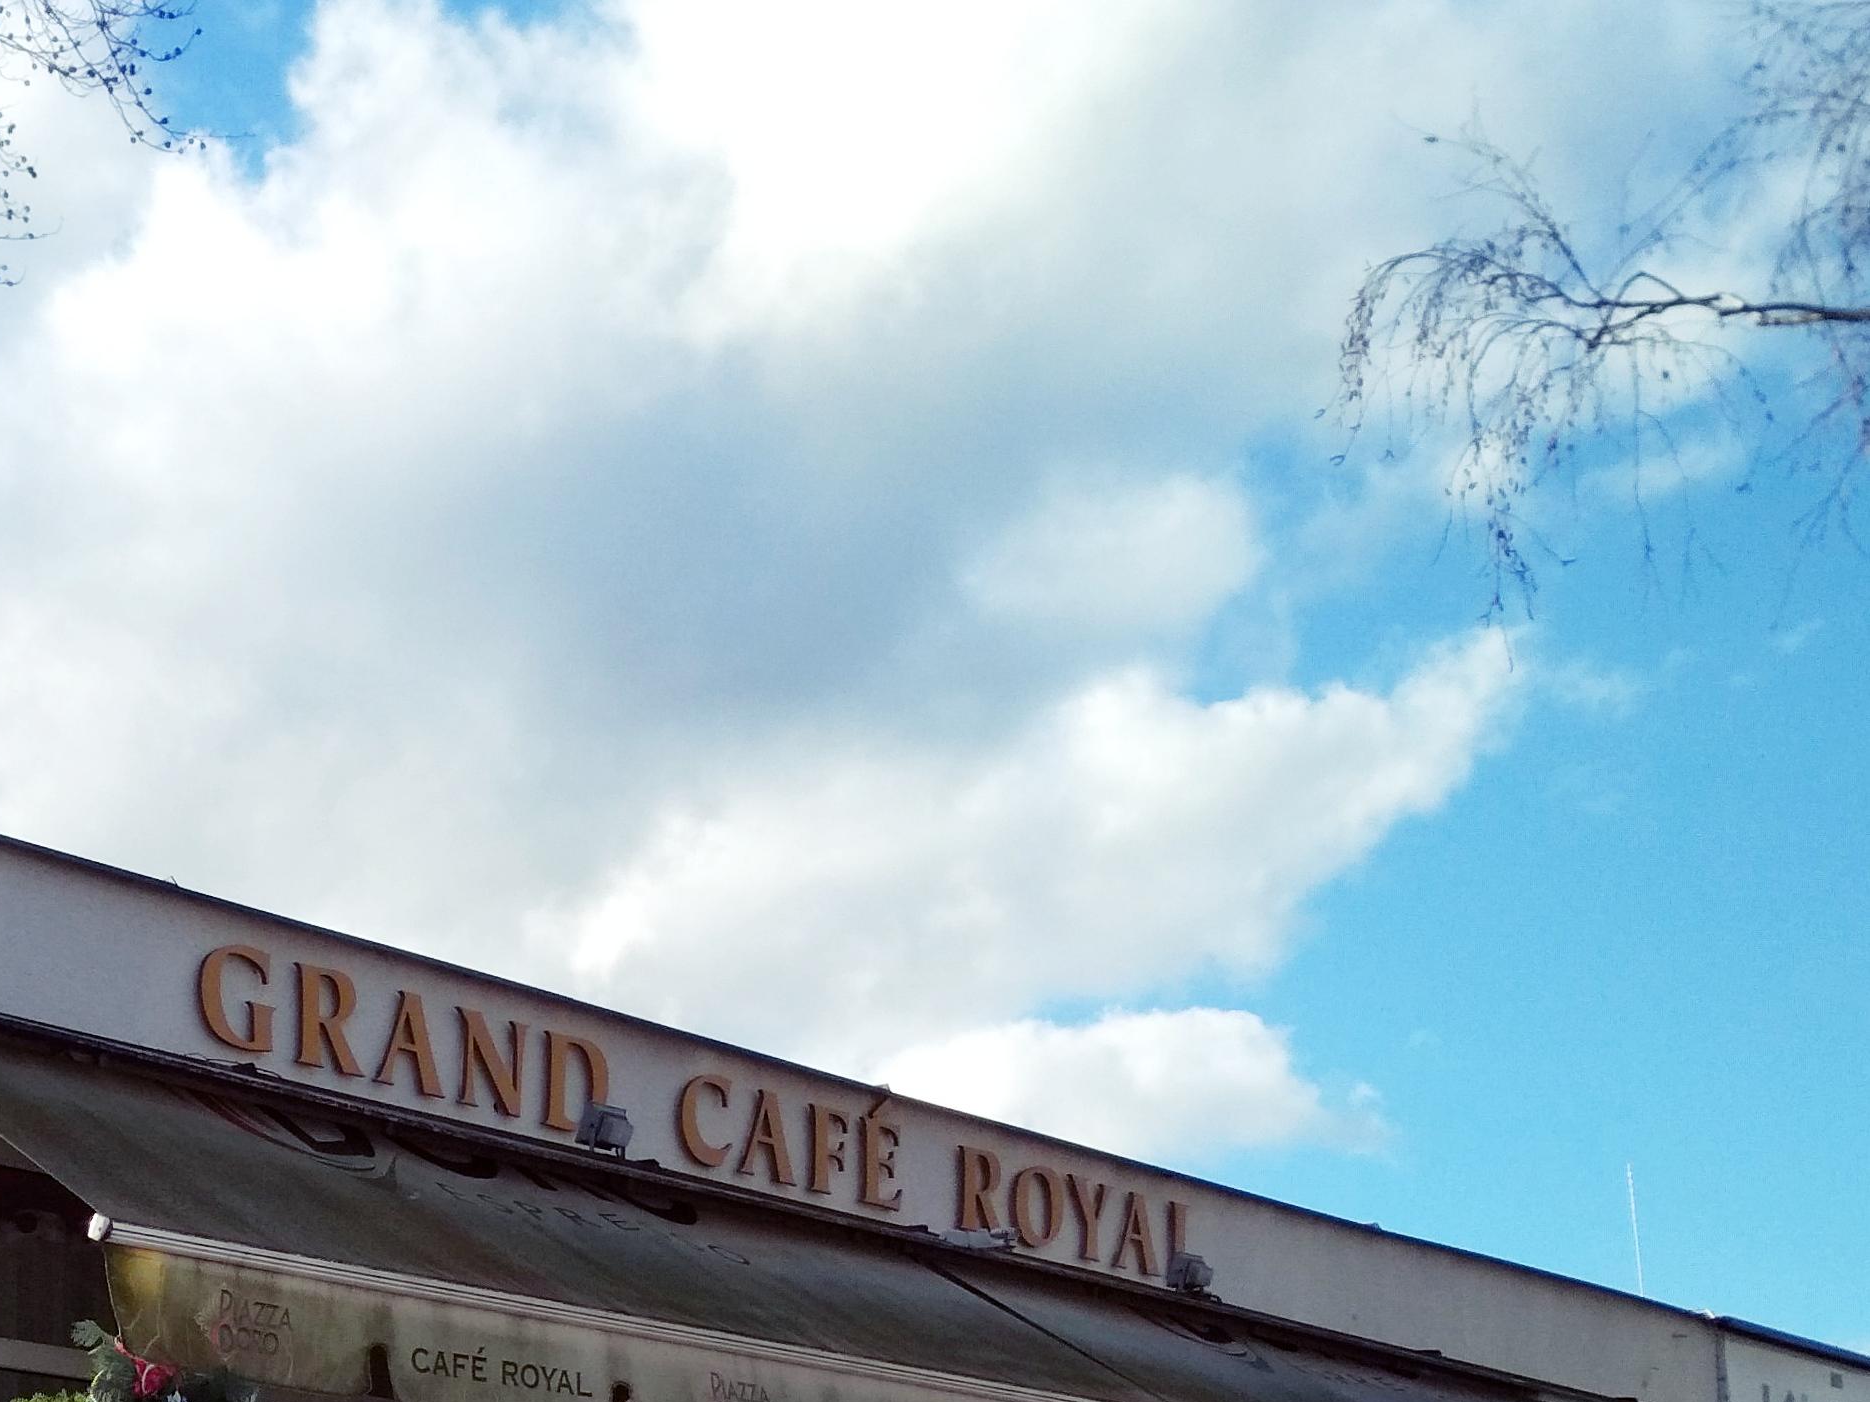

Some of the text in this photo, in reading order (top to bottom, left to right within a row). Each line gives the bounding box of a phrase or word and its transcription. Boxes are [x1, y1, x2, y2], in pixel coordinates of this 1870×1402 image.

[197, 944, 611, 1132] GRAND
[679, 1074, 903, 1211] CAFÉ
[219, 1288, 293, 1331] PIAZZA
[411, 1346, 593, 1398] CAFÉ ROYAL
